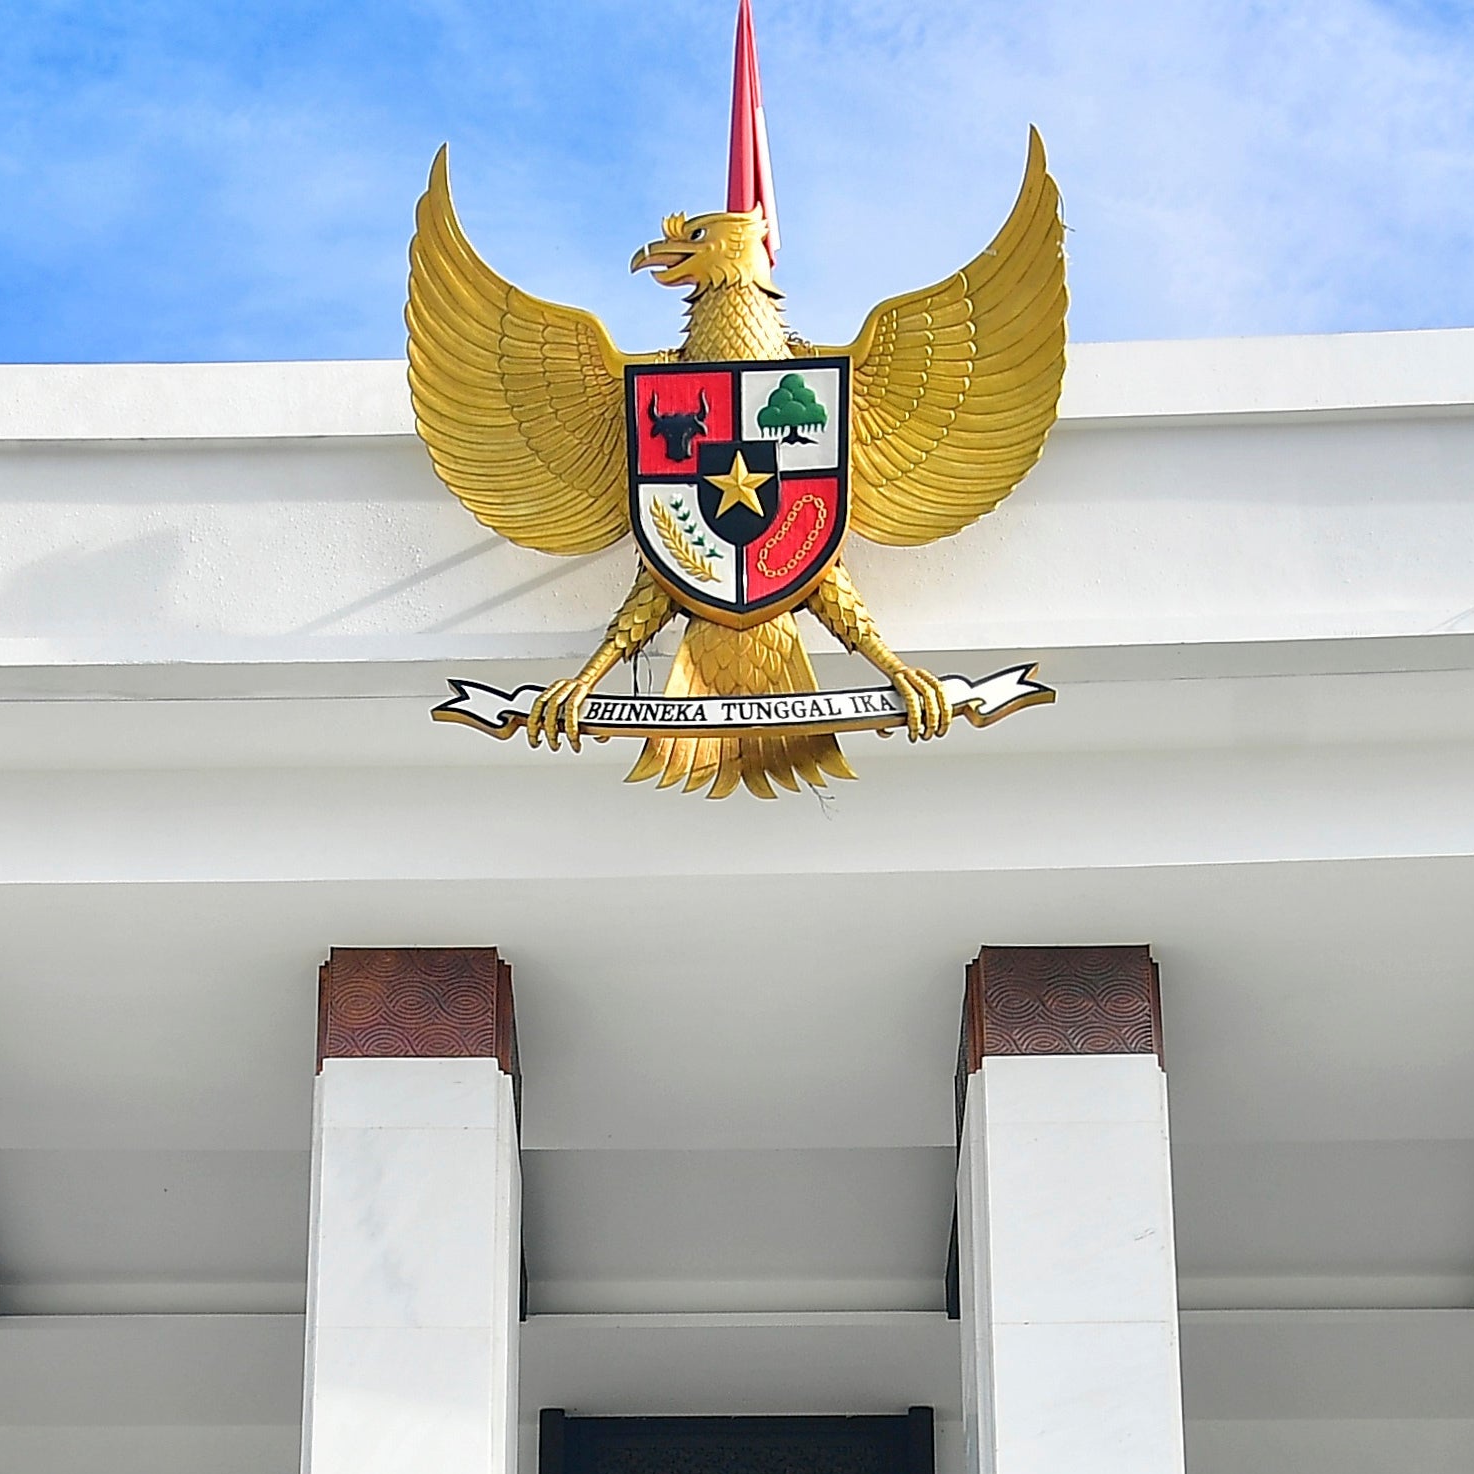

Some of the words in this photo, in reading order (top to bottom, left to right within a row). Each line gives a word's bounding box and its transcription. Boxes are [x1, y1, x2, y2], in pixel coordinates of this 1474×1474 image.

[583, 701, 708, 722] BHINNEKA
[721, 697, 843, 722] TUNGGAL
[849, 694, 897, 714] IKA
